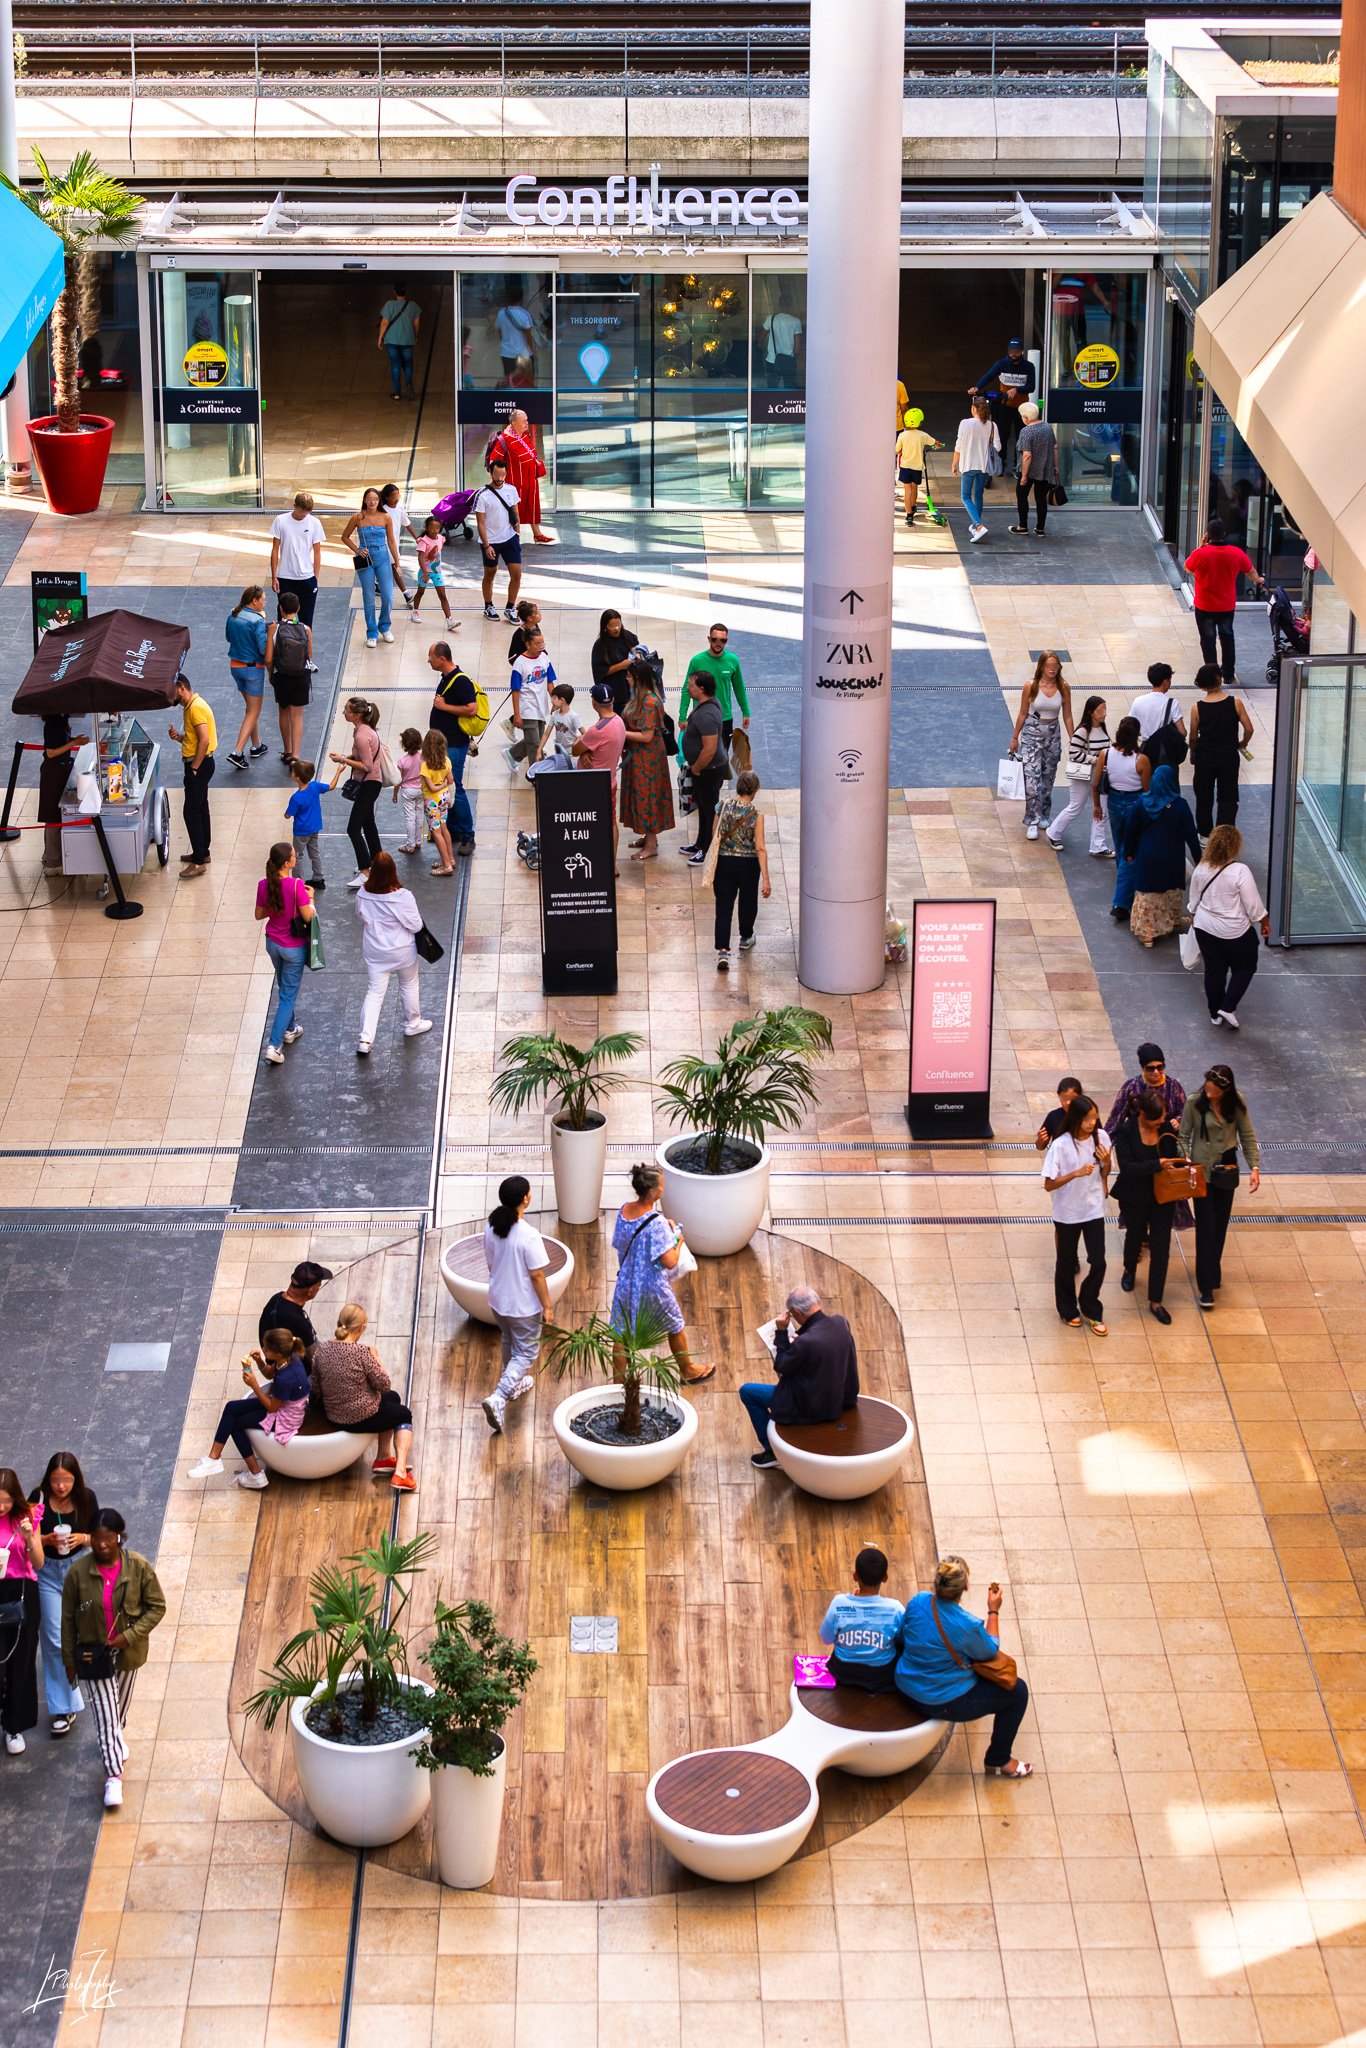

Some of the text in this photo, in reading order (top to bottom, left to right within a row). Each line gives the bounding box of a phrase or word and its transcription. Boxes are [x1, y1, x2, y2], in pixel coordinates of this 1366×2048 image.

[505, 173, 801, 226] Confluence
[571, 316, 618, 325] THE SORORITY
[180, 404, 242, 414] à Confluence
[768, 404, 774, 413] à
[35, 577, 48, 585] Jeff
[54, 576, 78, 586] Bruges
[125, 639, 157, 660] Bruges
[825, 642, 873, 665] ZARA
[123, 661, 145, 679] Jeff
[843, 691, 865, 700] Village
[554, 811, 598, 823] FONTAINE
[563, 828, 590, 841] À EAU
[951, 923, 985, 931] AIMEZ
[962, 933, 969, 942] ?
[937, 944, 964, 952] AIME
[919, 953, 970, 963] ÉCOUTER.
[925, 1070, 975, 1079] Confluence
